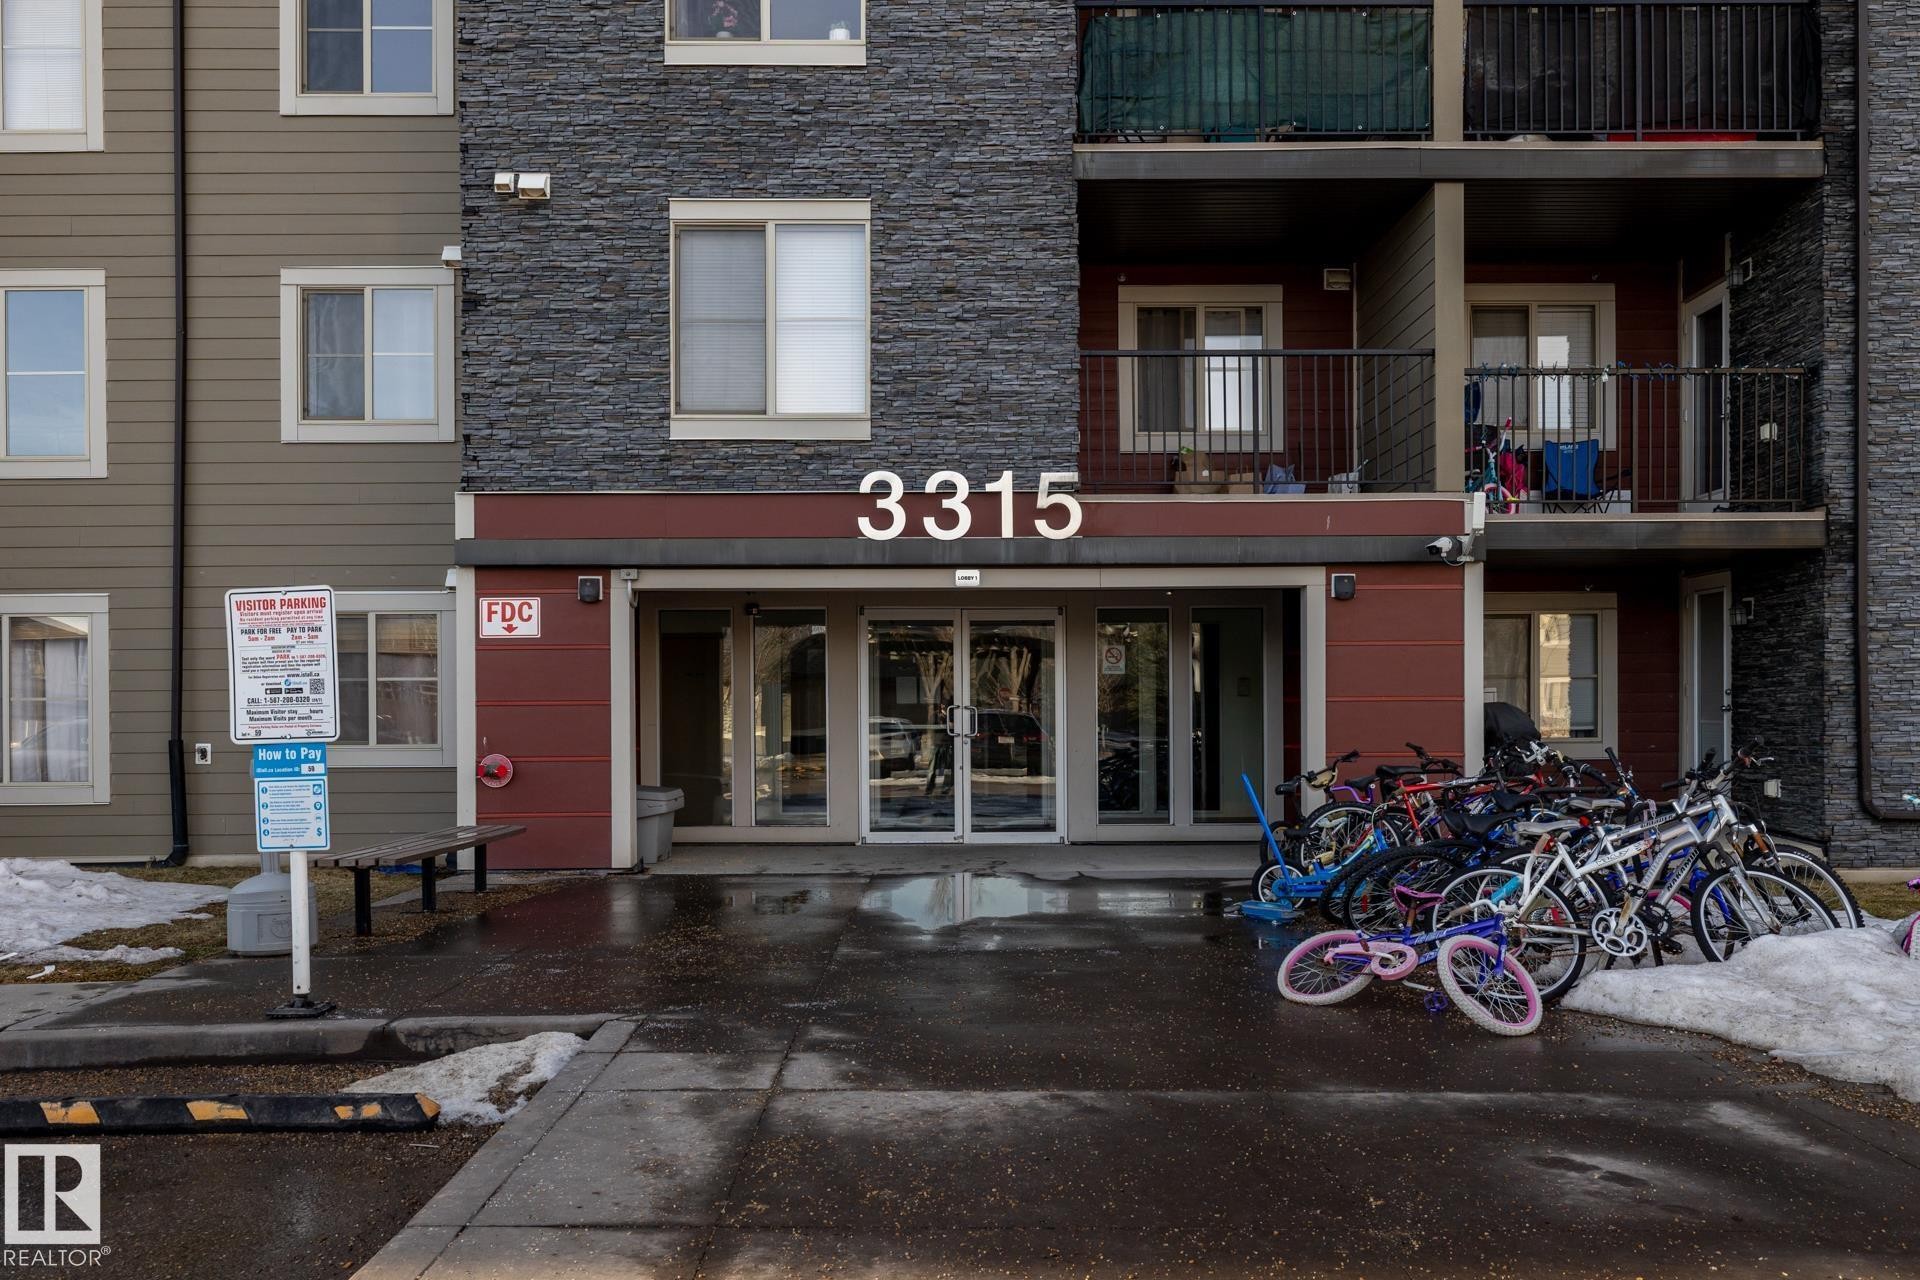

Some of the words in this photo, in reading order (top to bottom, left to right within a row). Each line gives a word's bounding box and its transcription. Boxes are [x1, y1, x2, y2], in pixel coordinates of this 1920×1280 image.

[857, 470, 1083, 541] 3315
[236, 599, 276, 611] VISITOR
[280, 597, 326, 609] PARKING
[486, 601, 533, 622] FDC
[258, 748, 282, 760] How
[285, 748, 296, 760] to
[301, 747, 322, 761] Pay
